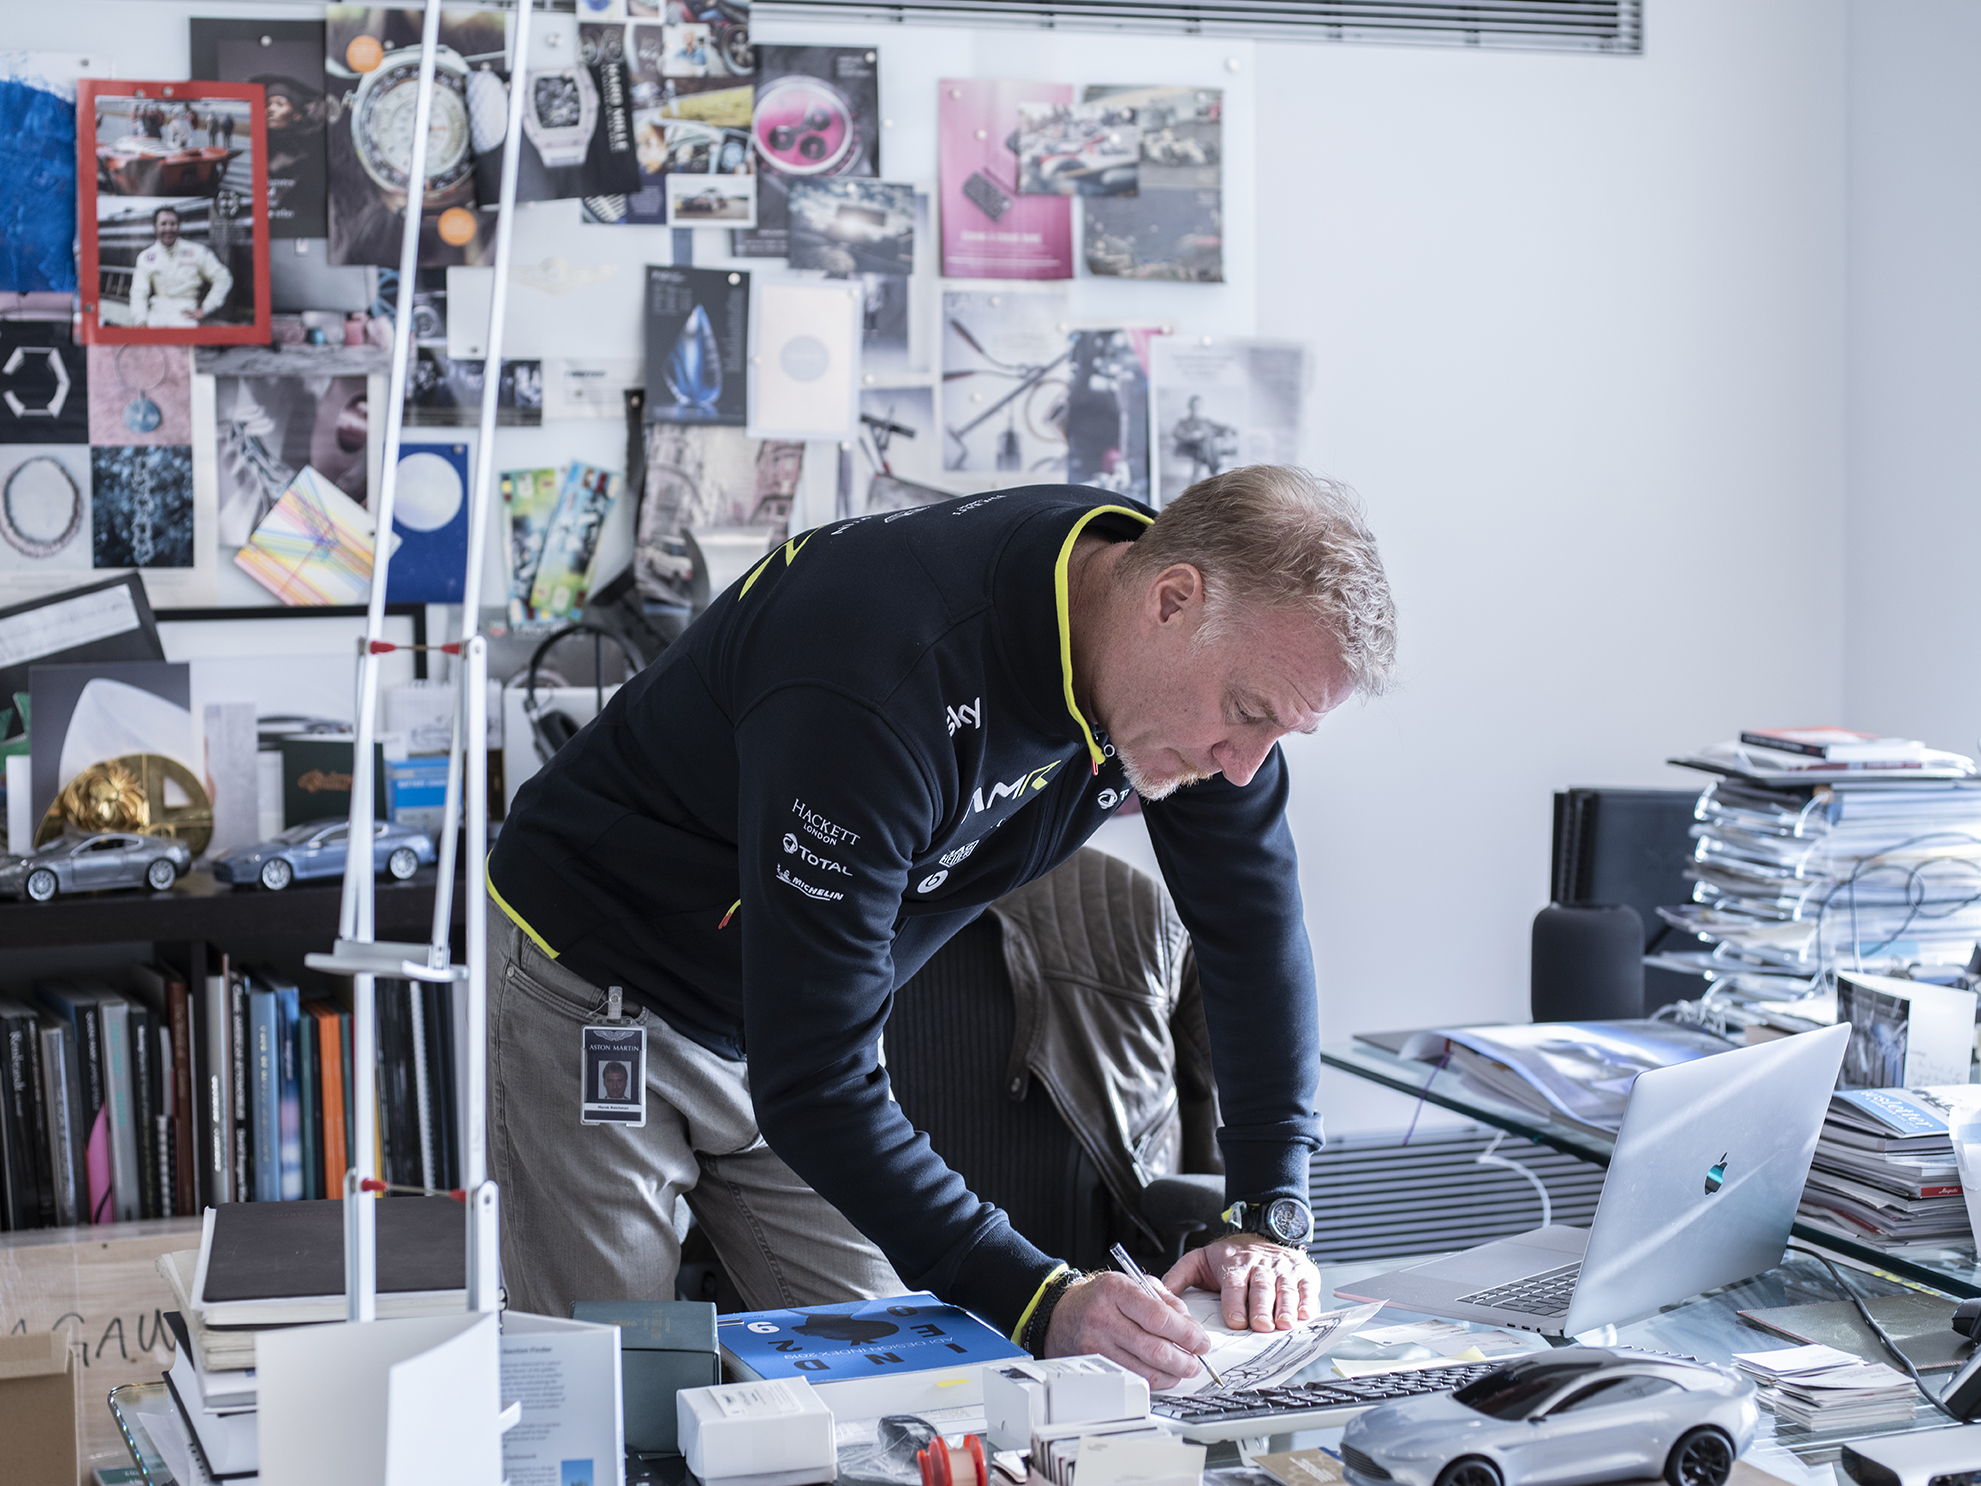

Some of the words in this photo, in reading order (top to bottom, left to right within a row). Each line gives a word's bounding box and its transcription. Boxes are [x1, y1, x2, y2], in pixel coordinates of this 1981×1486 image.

[791, 798, 861, 846] HACKETT
[803, 823, 838, 846] LONDON
[799, 845, 854, 877] TOTAL
[792, 876, 845, 901] MICHELIN
[613, 1044, 640, 1052] MARTIN
[929, 1336, 953, 1344] ADI
[869, 1341, 927, 1352] DESIGN
[784, 1352, 818, 1360] 2019
[822, 1348, 867, 1357] INDEX
